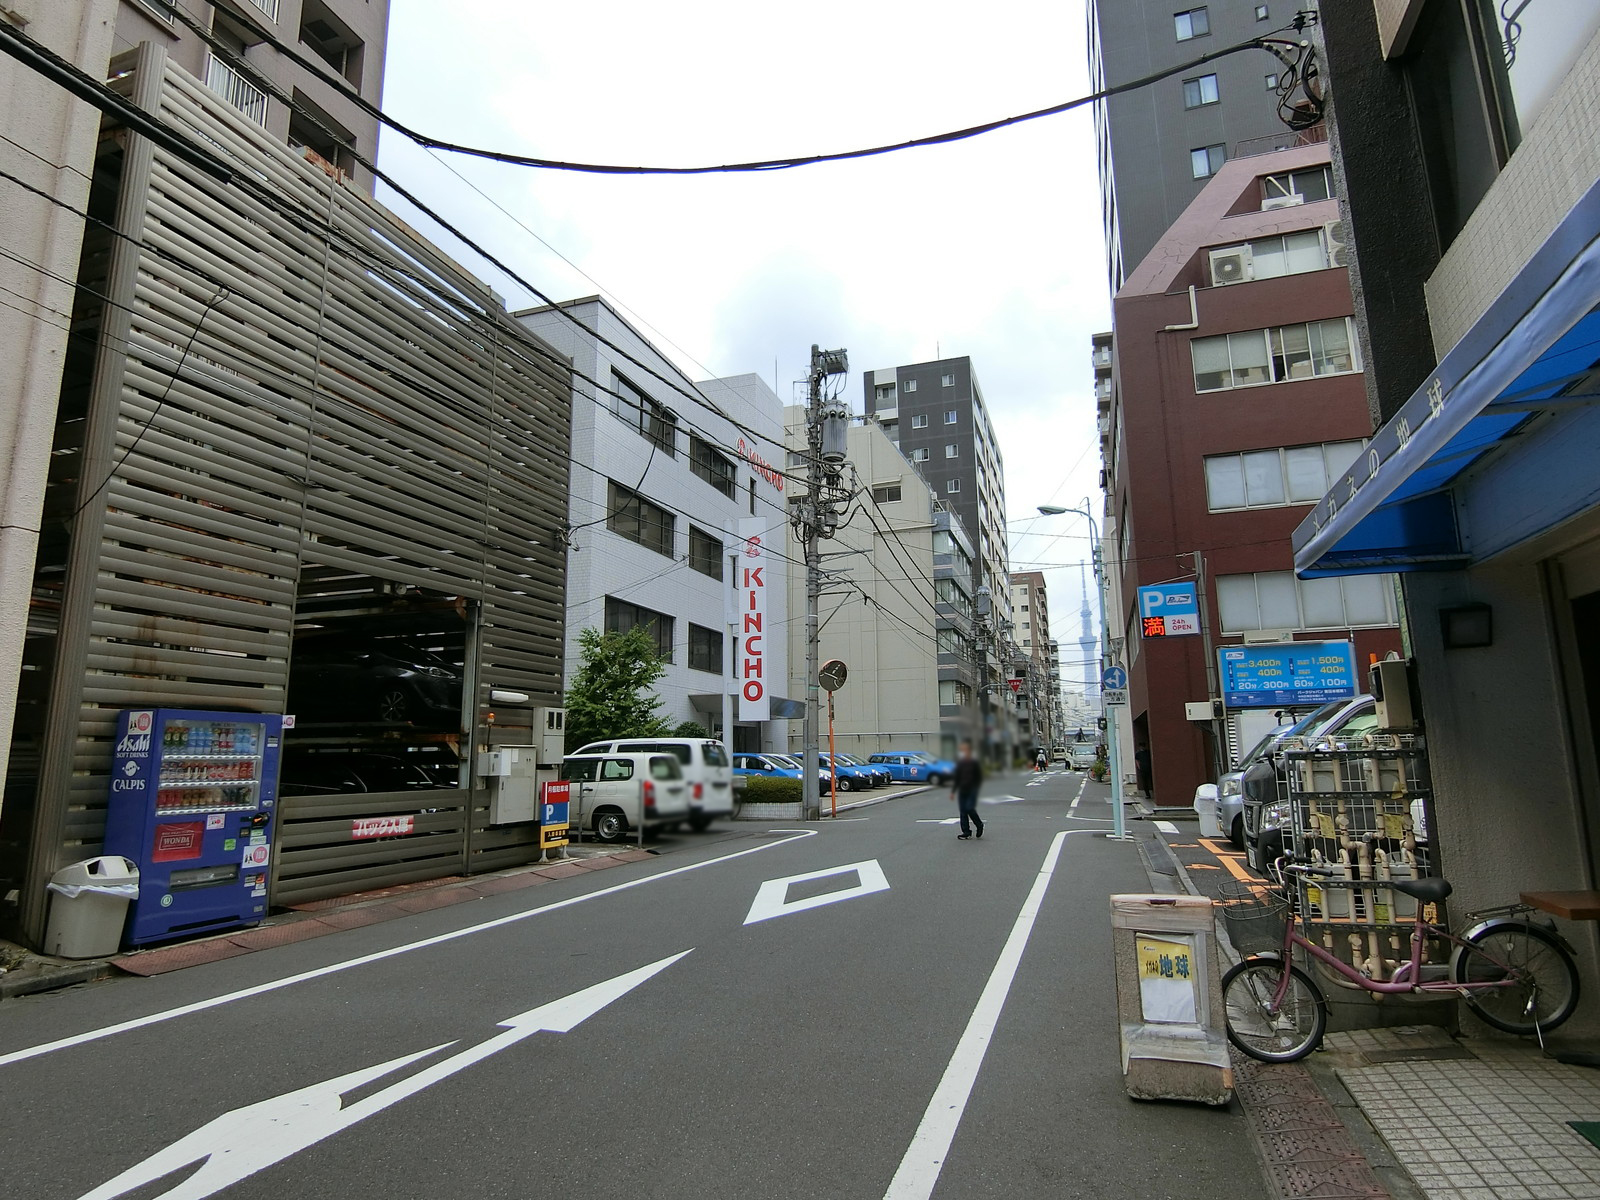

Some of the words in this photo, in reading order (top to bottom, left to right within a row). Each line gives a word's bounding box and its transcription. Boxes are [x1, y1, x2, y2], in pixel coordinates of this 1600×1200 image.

[1313, 377, 1444, 540] メガネの地球
[1143, 591, 1164, 617] P
[743, 567, 764, 702] KINCHO
[1143, 617, 1165, 636] 満
[1320, 665, 1345, 673] 400円
[117, 734, 151, 752] Asahi
[112, 779, 146, 792] CALPIS
[545, 804, 555, 821] P
[357, 817, 409, 836] バック入庫
[163, 836, 190, 845] WONDA
